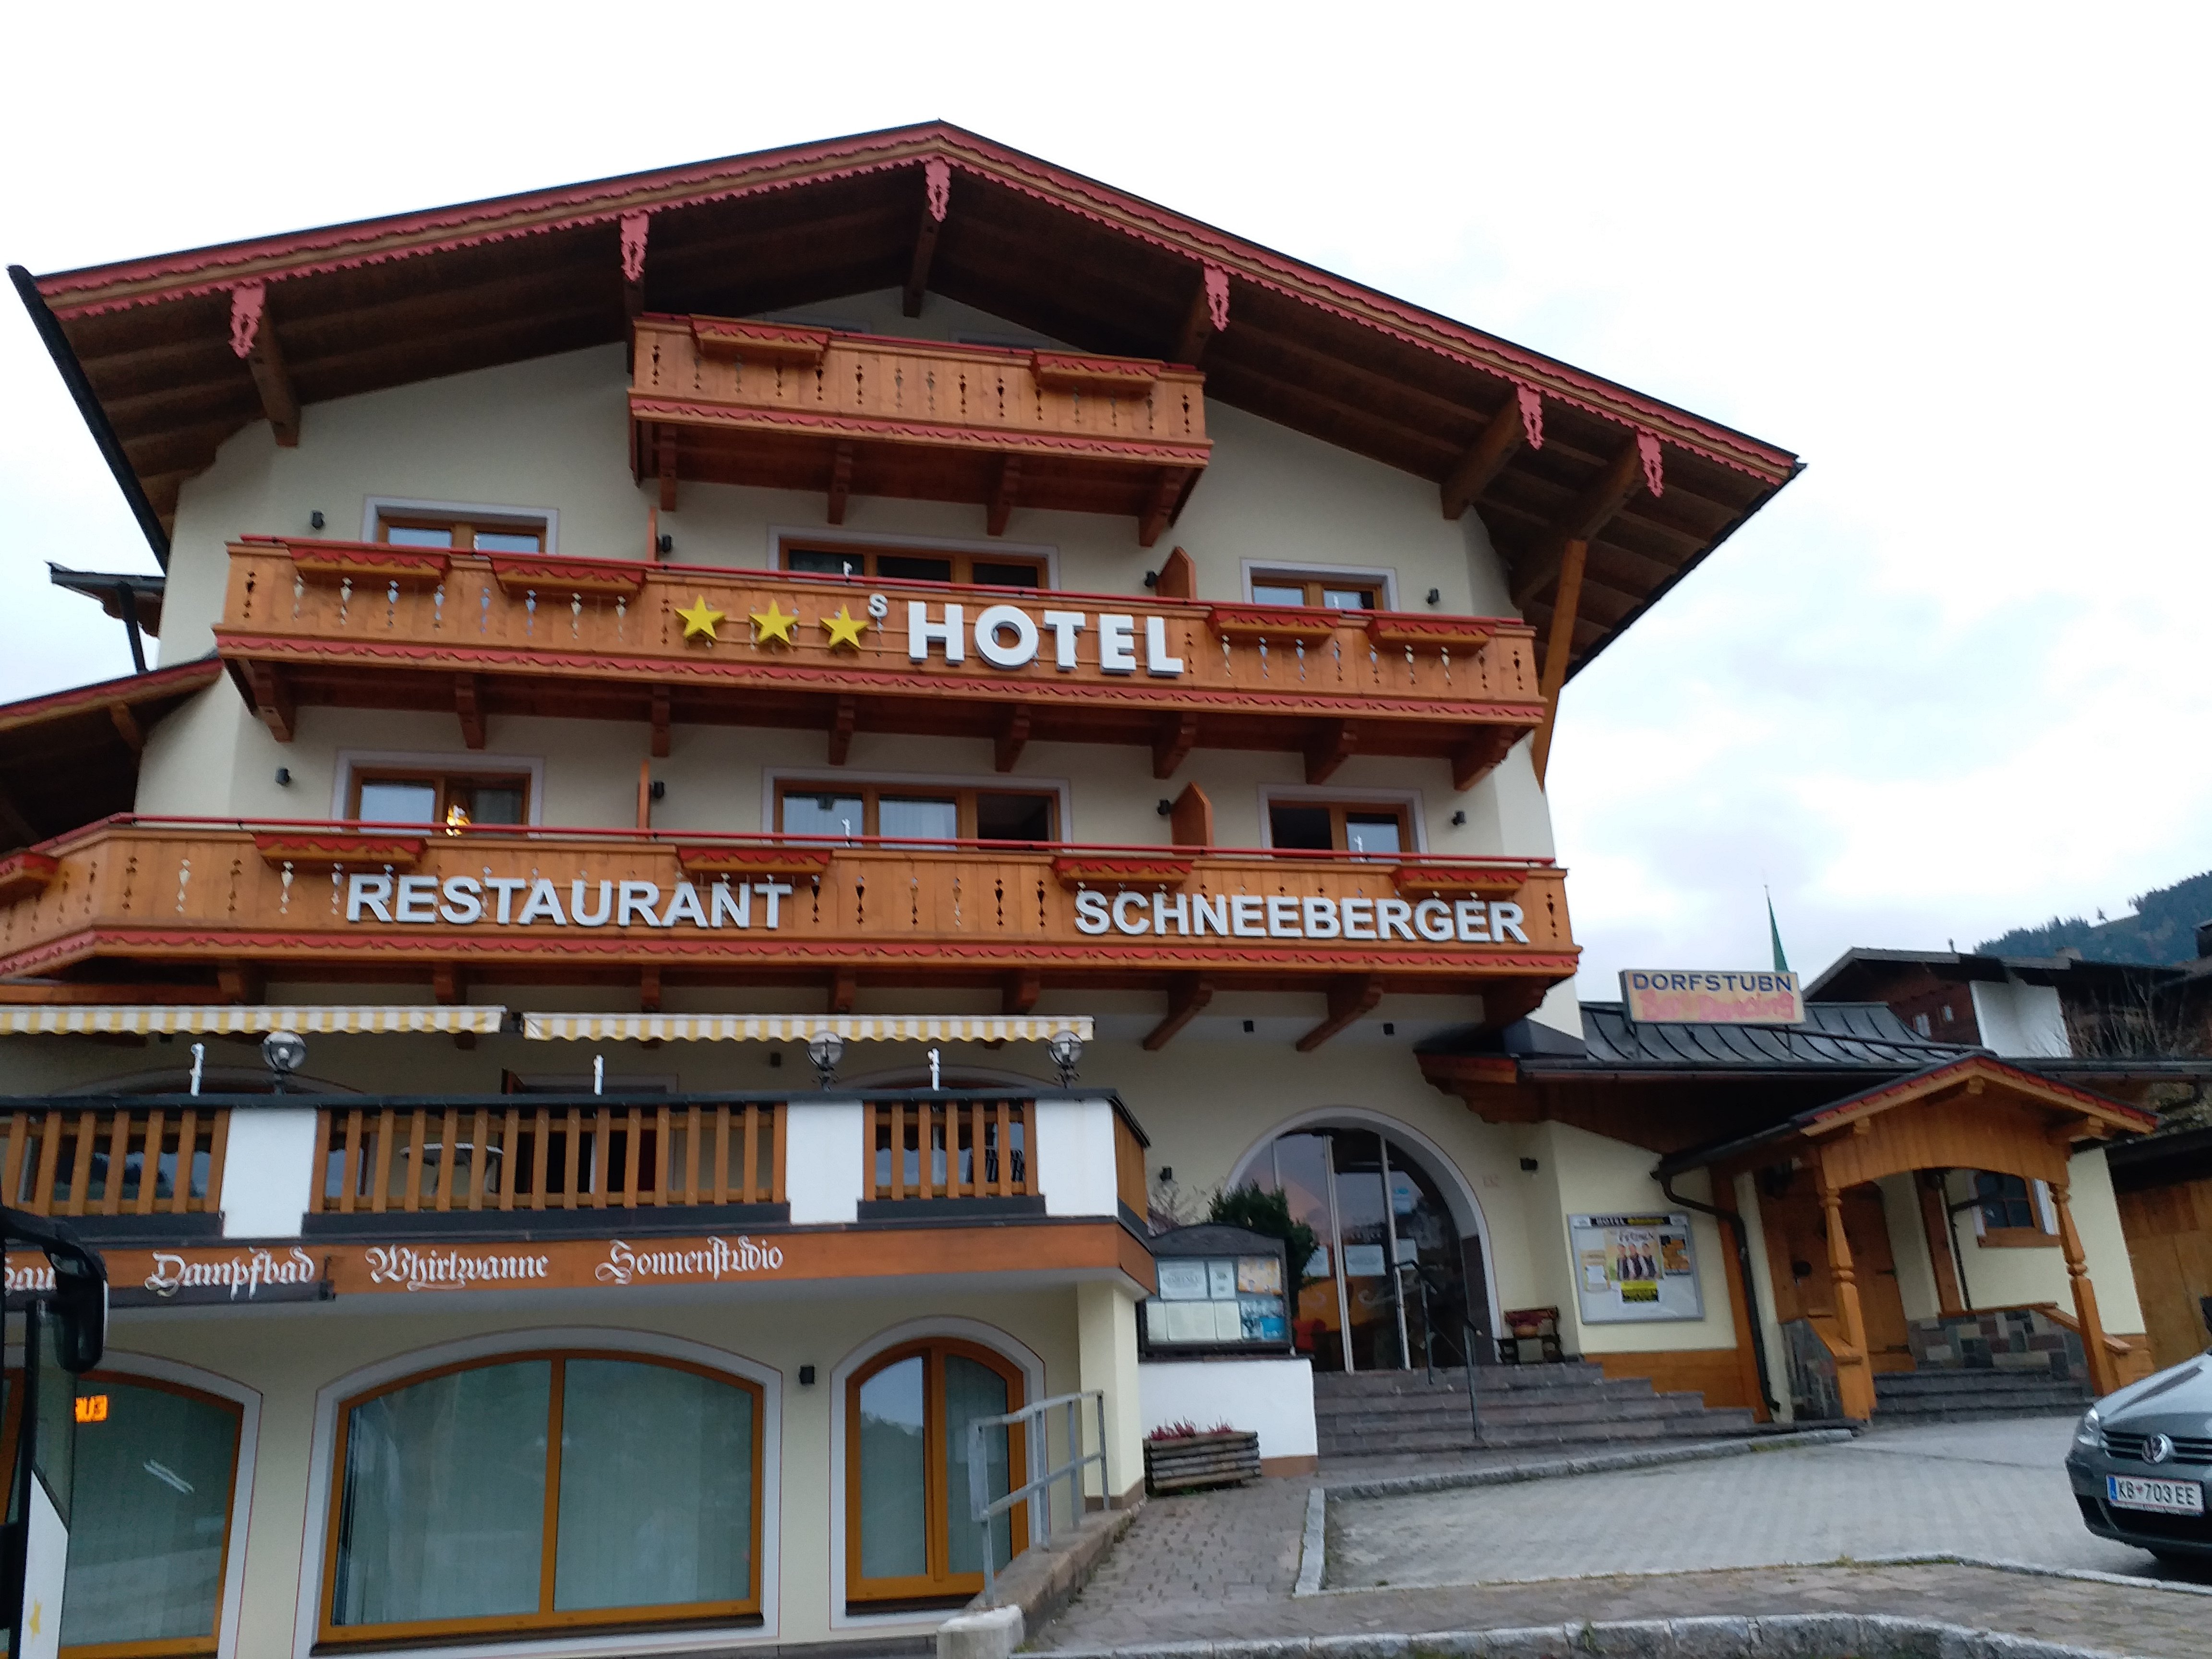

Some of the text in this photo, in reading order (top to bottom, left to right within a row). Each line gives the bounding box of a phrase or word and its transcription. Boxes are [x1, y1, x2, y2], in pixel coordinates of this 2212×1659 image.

[908, 600, 1184, 678] HOTEL
[345, 872, 1530, 944] RESTAURANT SCHNEEBERGER
[1632, 973, 1793, 993] DORFSTUBN
[144, 1245, 315, 1301] Dampfbad
[365, 1243, 549, 1292] Whirlwanne
[595, 1235, 783, 1286] Sonnenstudio
